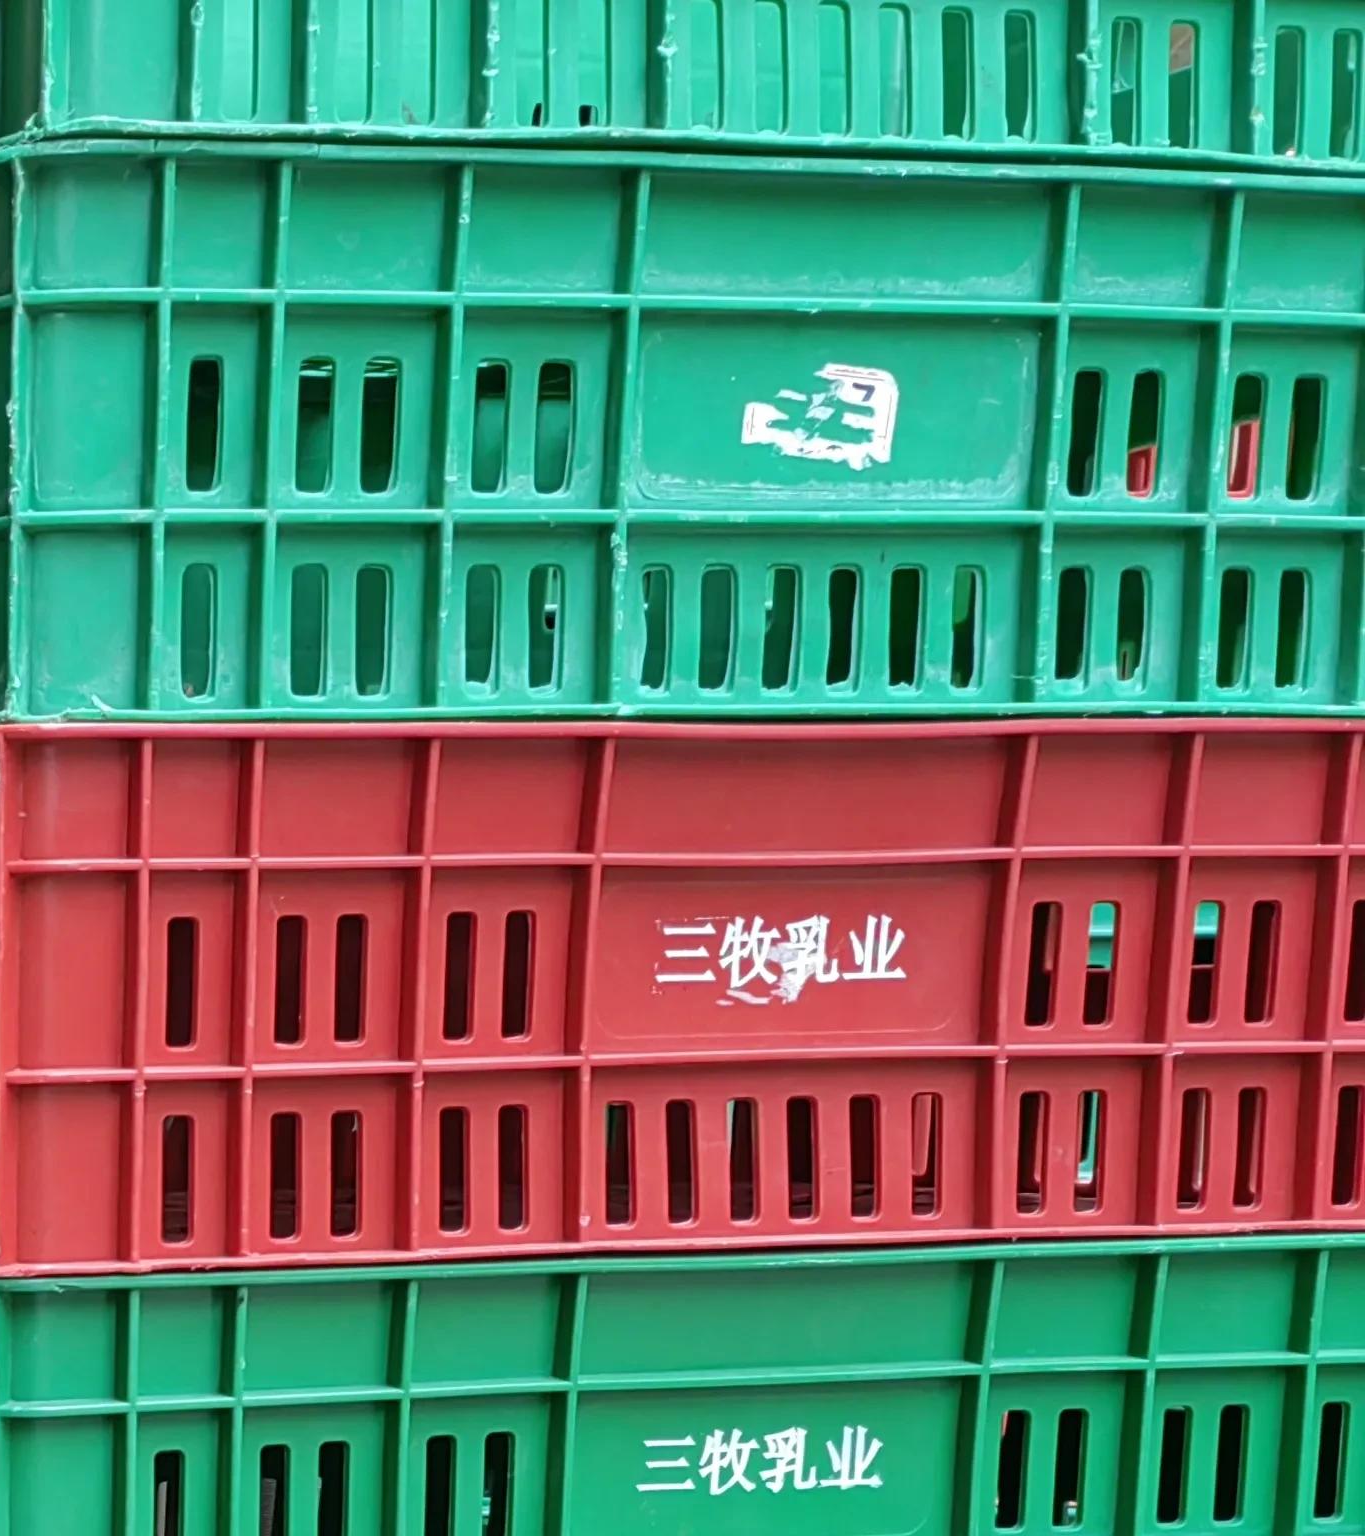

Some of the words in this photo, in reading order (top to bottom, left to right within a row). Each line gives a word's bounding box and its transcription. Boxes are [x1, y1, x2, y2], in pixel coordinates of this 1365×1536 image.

[652, 911, 909, 984] 三牧乳业
[634, 1423, 885, 1496] 三牧乳业
